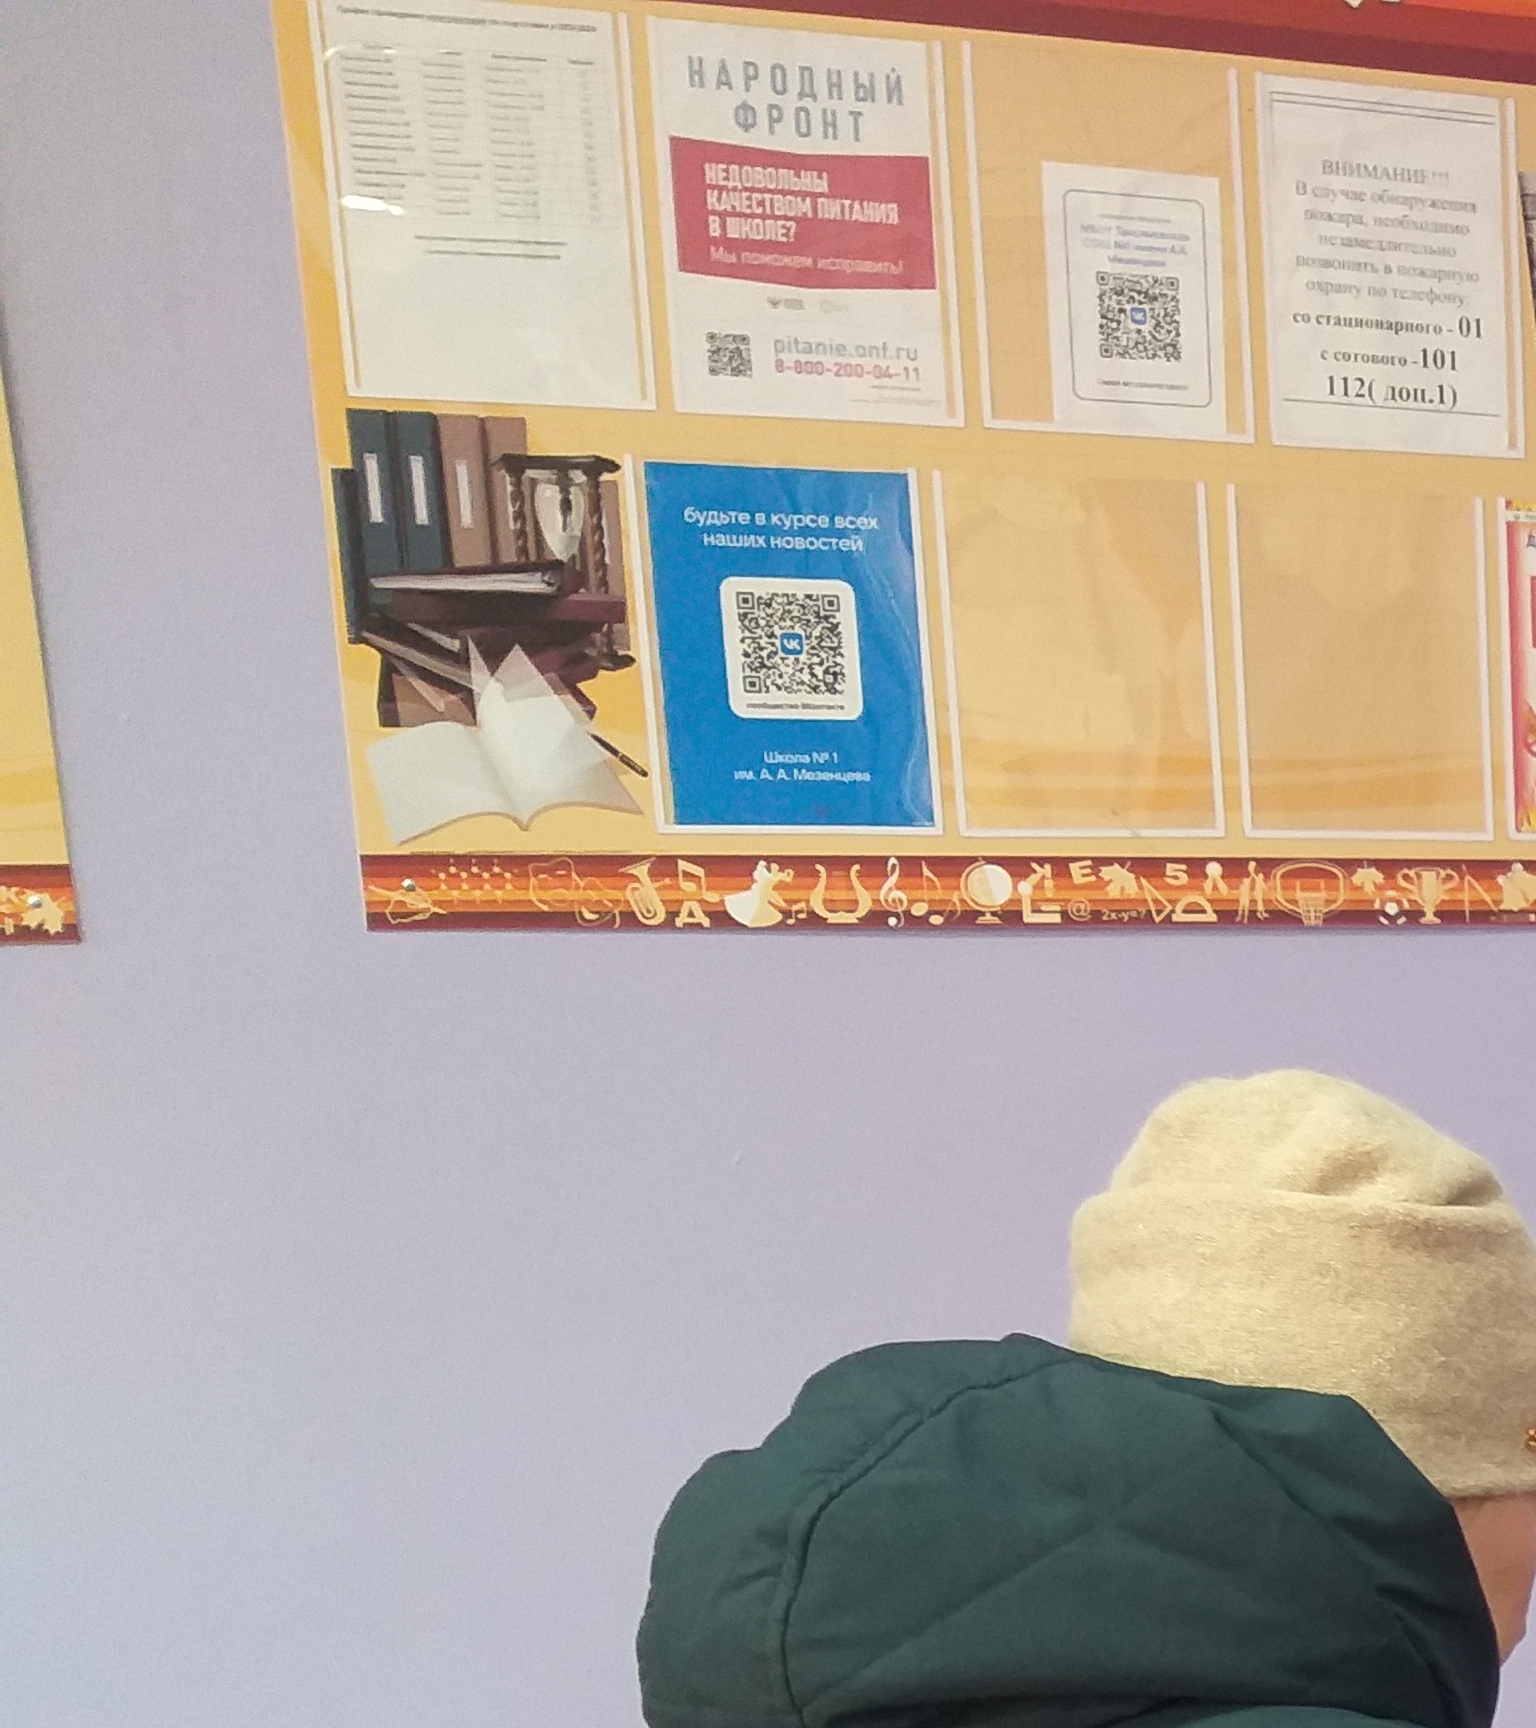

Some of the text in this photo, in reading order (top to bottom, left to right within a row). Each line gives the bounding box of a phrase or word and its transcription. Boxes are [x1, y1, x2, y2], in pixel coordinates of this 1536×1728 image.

[688, 55, 904, 106] НАРОДНЫЙ
[734, 100, 864, 142] ФРОНТ
[704, 162, 828, 193] НЕДОВОЛЬНЫ
[706, 189, 899, 224] КАЧЕСТВОМ ПИТАНИЯ
[1296, 180, 1478, 213] В случае обнаружения
[709, 216, 796, 242] В ШКОЛЕ?
[1296, 255, 1379, 275] позвонить
[1368, 286, 1387, 298] по
[1293, 312, 1311, 324] со
[1316, 313, 1443, 336] стационарного
[1459, 315, 1482, 339] 01
[773, 335, 918, 362] pitanie.onf.ru
[1320, 349, 1329, 361] с
[1334, 350, 1408, 367] сотового
[683, 506, 879, 530] будьте в курсе всех
[703, 532, 864, 552] наших новостей
[763, 751, 811, 764] Школа
[1163, 862, 1189, 886] 5
